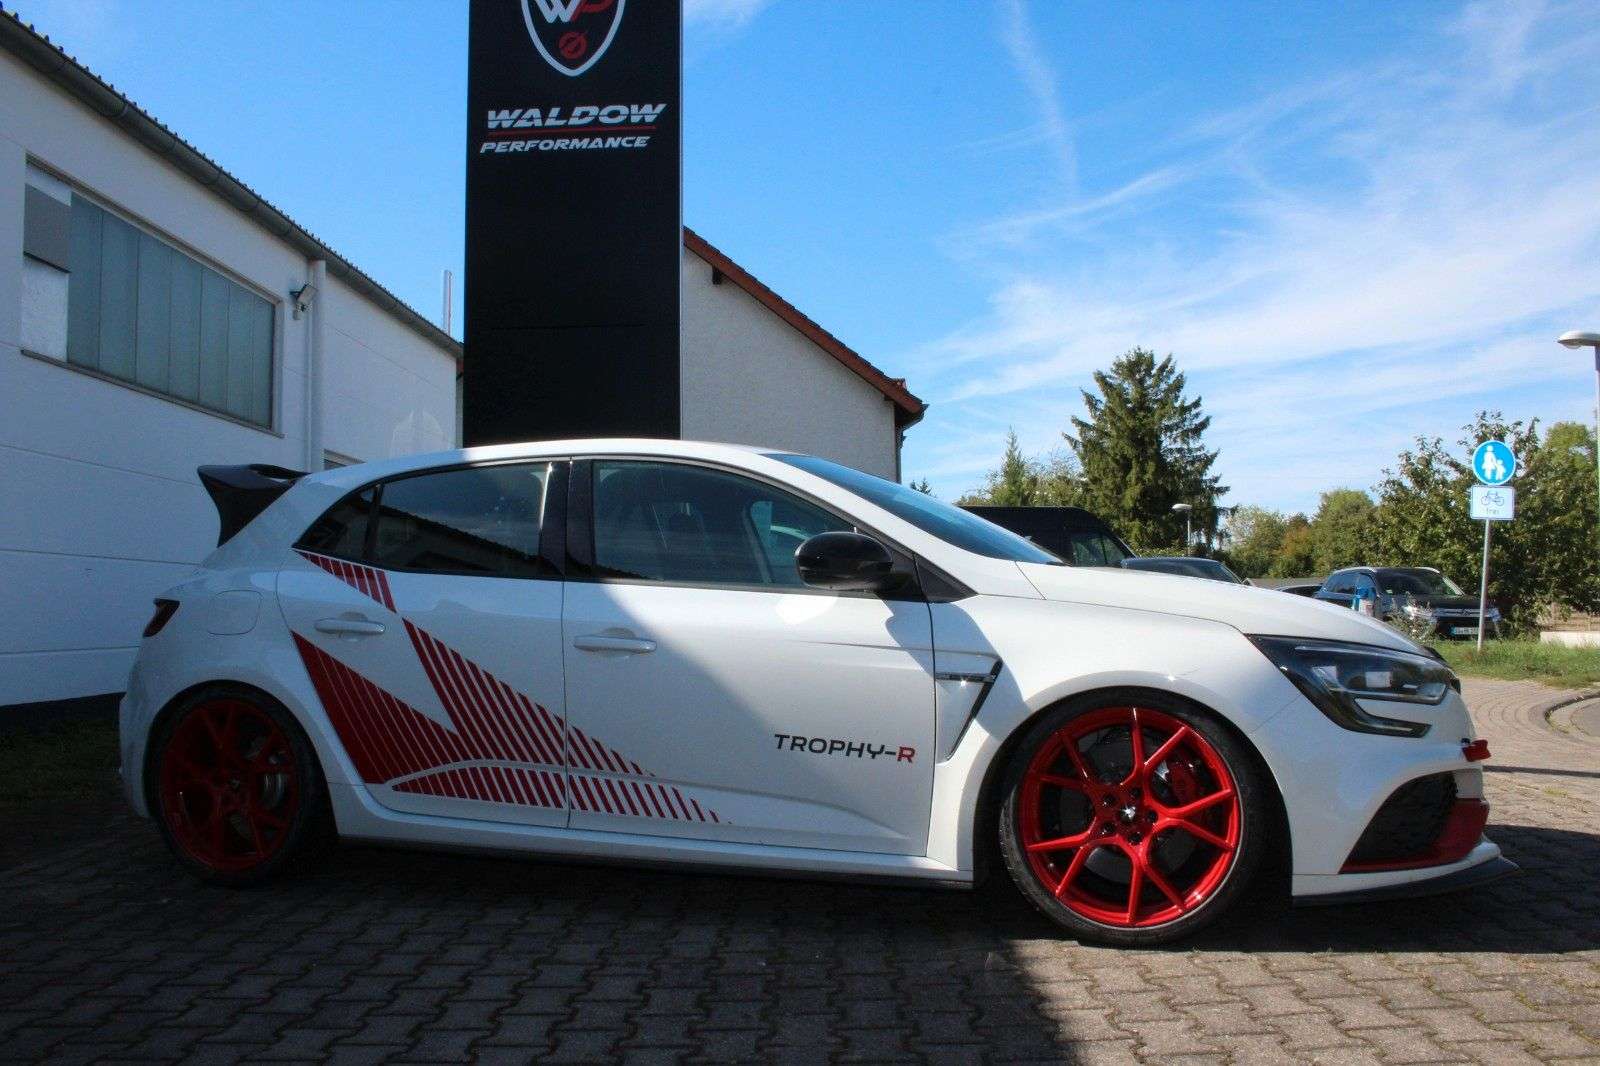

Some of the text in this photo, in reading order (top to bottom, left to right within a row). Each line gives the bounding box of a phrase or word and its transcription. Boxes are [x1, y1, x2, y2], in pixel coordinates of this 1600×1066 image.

[487, 103, 667, 129] WALDOW
[480, 136, 650, 153] PERFORMANCE
[774, 733, 916, 763] TROPHY-R
